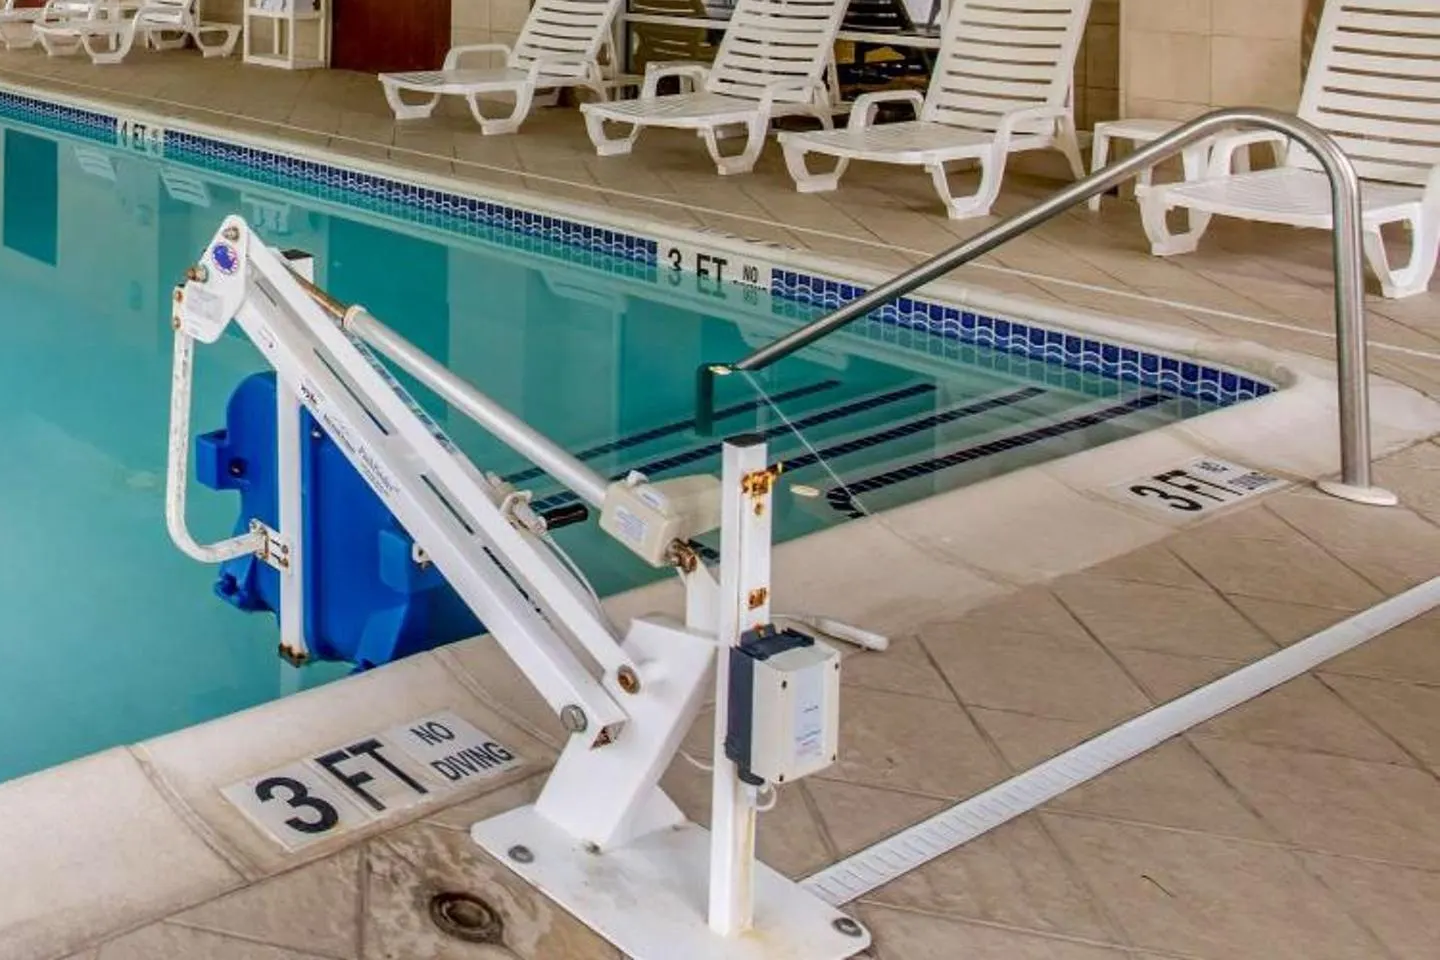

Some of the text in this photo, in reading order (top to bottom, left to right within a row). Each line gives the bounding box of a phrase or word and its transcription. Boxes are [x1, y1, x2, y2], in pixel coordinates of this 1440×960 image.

[667, 248, 728, 282] 3 FT
[1129, 485, 1203, 511] 3
[1153, 469, 1244, 502] FT
[410, 722, 455, 746] NO
[430, 742, 515, 781] DIVING
[255, 738, 429, 833] 3 FT
